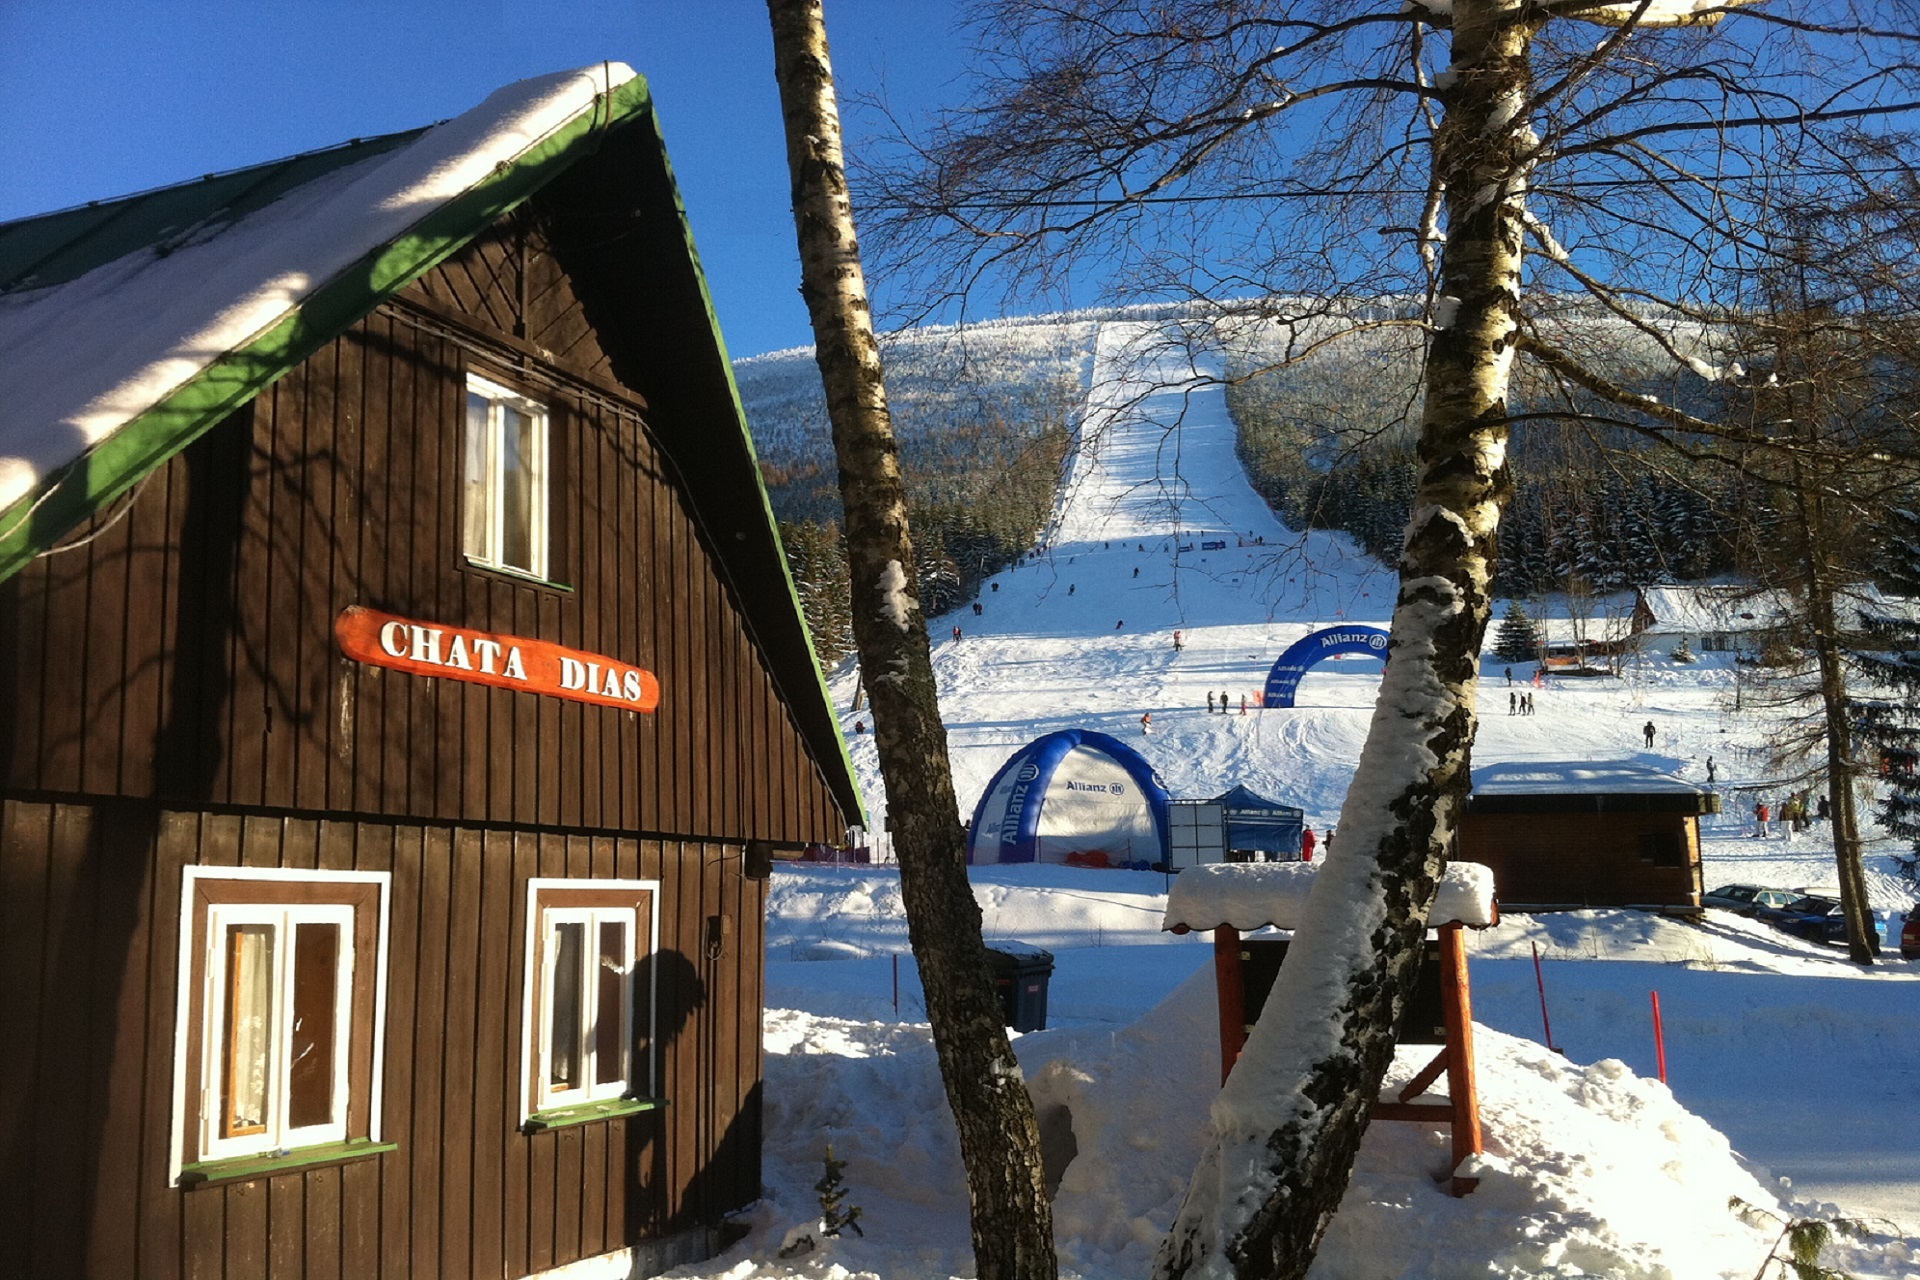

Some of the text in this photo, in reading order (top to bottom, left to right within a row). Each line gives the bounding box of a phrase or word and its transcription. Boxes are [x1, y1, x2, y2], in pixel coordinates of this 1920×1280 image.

[1321, 633, 1369, 648] Allianz
[380, 620, 642, 702] CHATA DIAS
[1066, 781, 1107, 792] Allianz
[1002, 785, 1029, 845] Allianz
